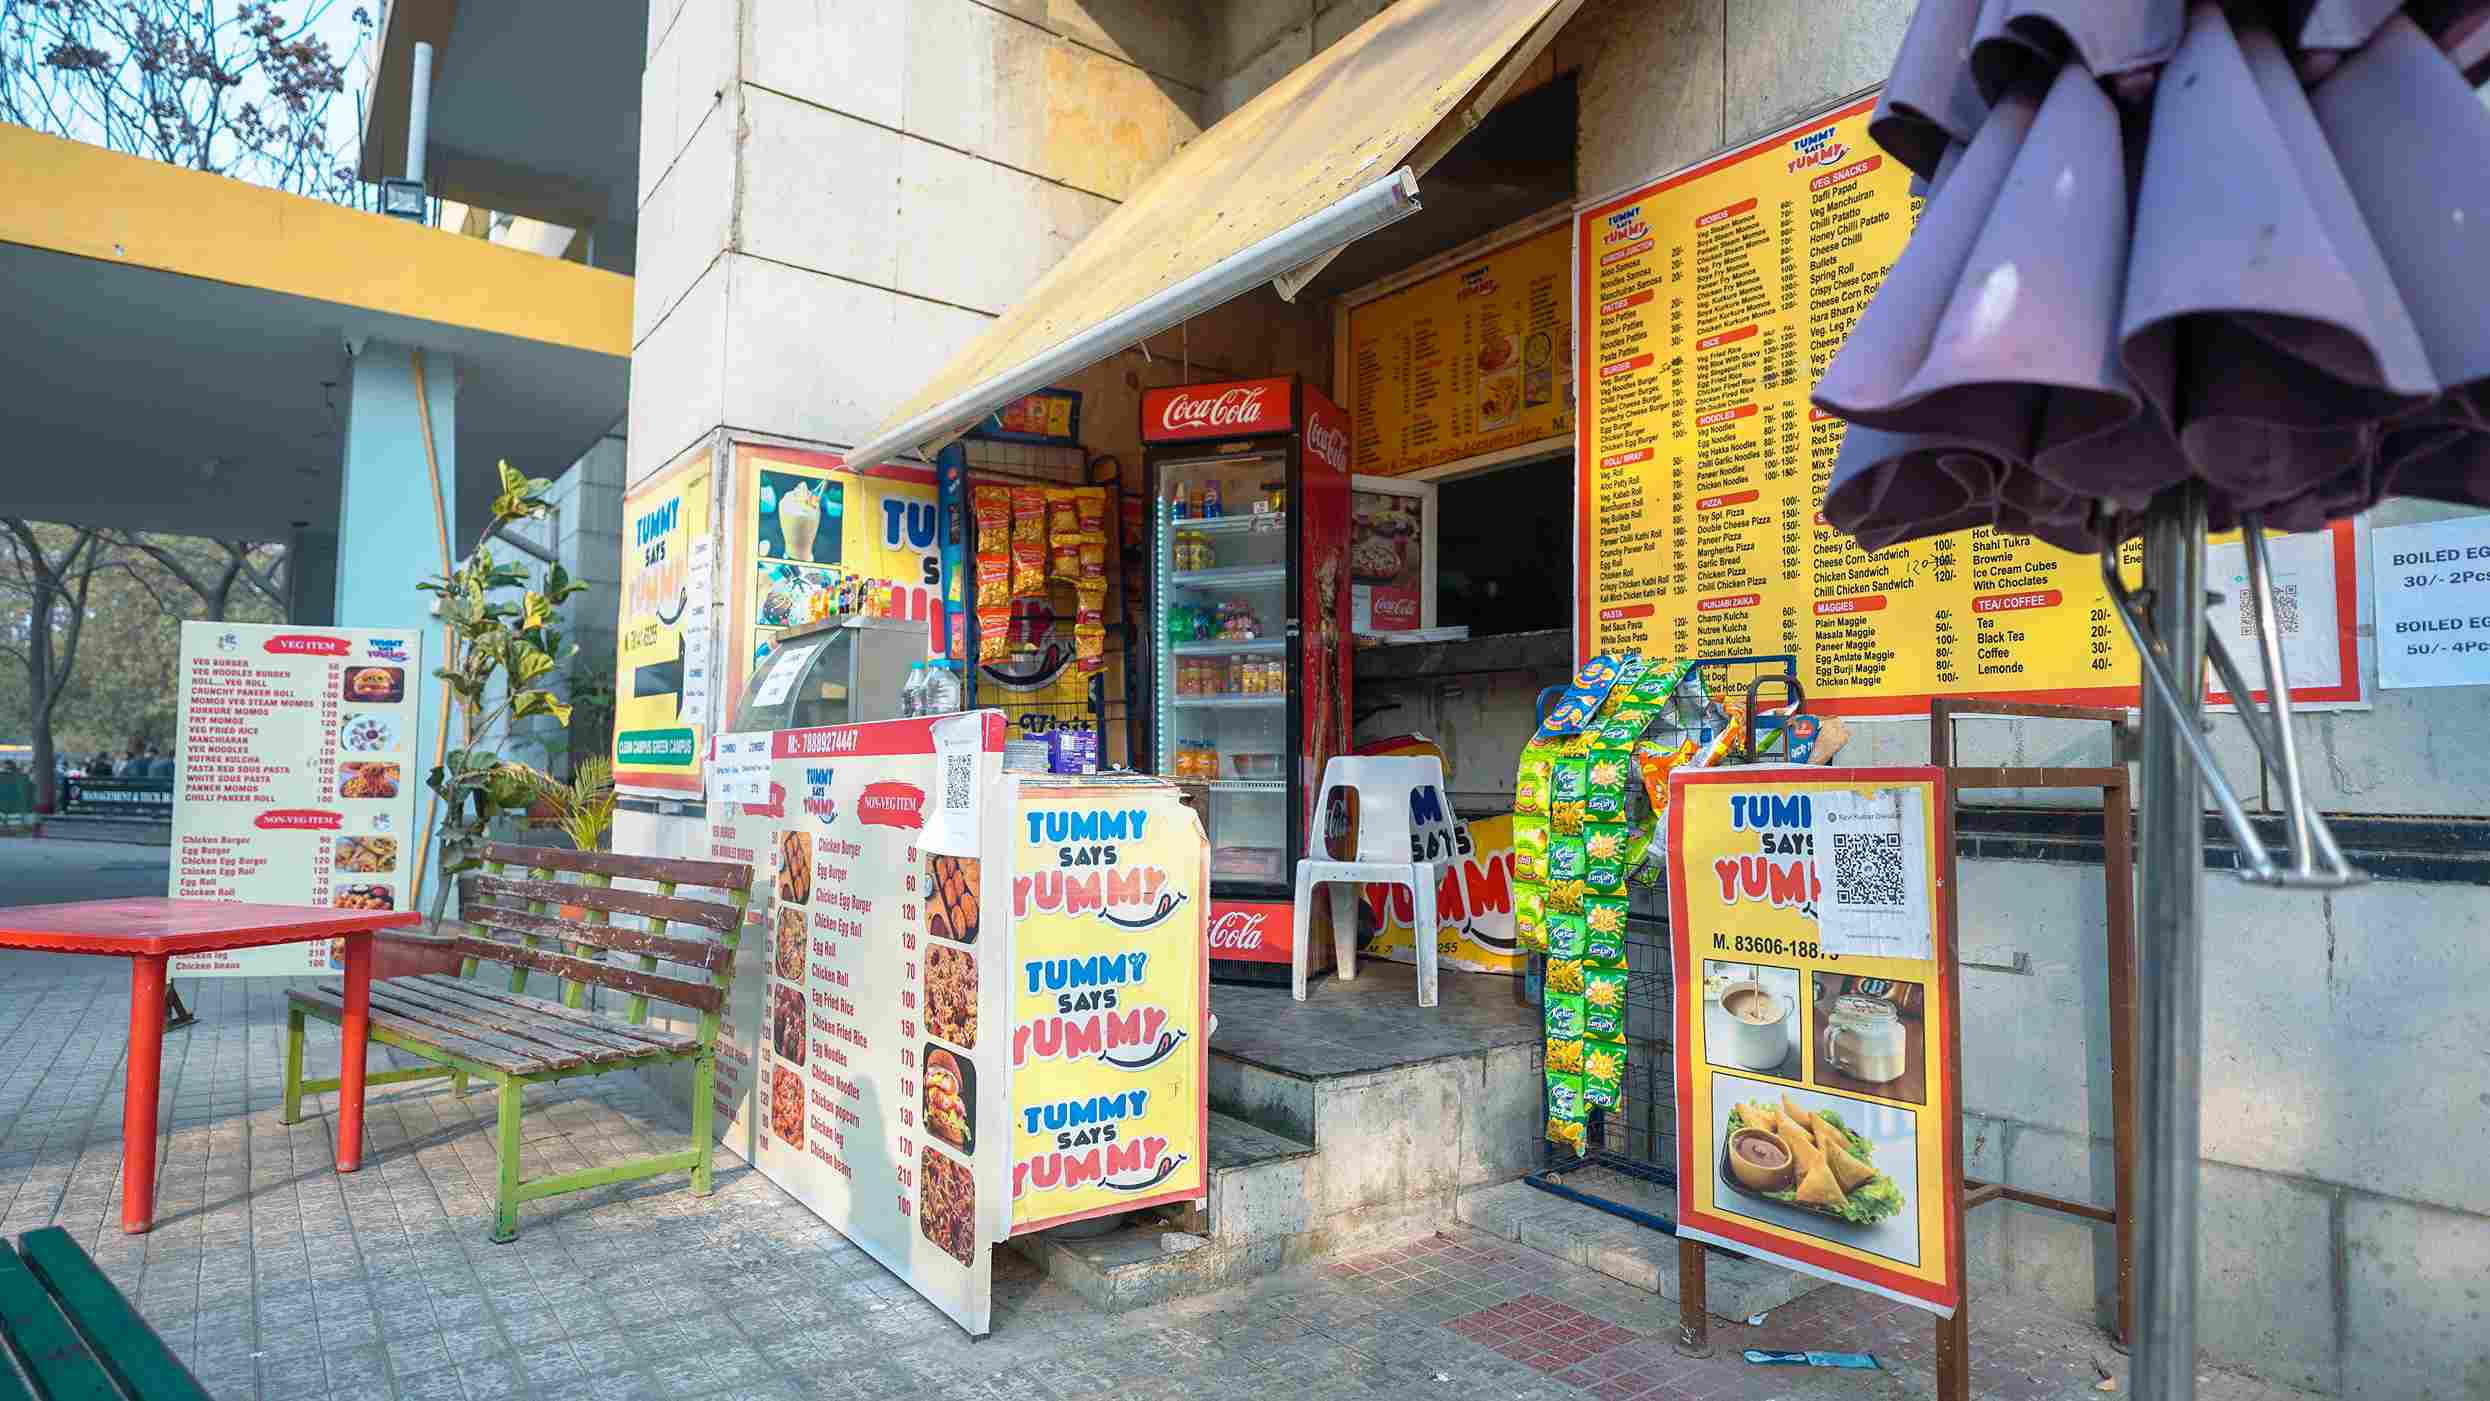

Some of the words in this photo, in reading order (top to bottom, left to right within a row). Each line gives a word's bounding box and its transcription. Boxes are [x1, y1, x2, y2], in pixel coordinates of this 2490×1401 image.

[1793, 127, 1836, 151] TUMMY
[1787, 144, 1845, 175] YUMMY
[1812, 177, 1831, 190] VEG
[1832, 162, 1868, 183] SNACKS
[1810, 207, 1825, 218] Veg
[1810, 230, 1835, 244] Honey
[1810, 242, 1839, 257] Cheese
[1810, 271, 1836, 285] Spring
[1838, 263, 1854, 276] Roll
[1810, 285, 1832, 298] Crispy
[1860, 271, 1879, 282] Corn
[1810, 295, 1839, 311] Cheese
[1841, 288, 1862, 302] Corn
[1810, 311, 1829, 324] Hara
[1831, 303, 1854, 319] Bhara
[636, 497, 680, 547] TUMMY
[1752, 516, 1771, 526] Pizza
[1934, 539, 1956, 550] 100/-
[1972, 540, 2000, 552] Shahi
[2003, 536, 2031, 548] Tukra
[645, 541, 666, 567] SAYS
[1813, 558, 1843, 569] Cheese
[1846, 555, 1865, 565] Corn
[1867, 548, 1909, 562] Sandwich
[1973, 551, 2013, 565] Brownie
[2393, 548, 2461, 567] BOILED
[1727, 568, 1746, 577] Pizza
[1814, 571, 1846, 583] Chicken
[1848, 566, 1889, 580] Sandwich
[1973, 567, 1988, 578] Ice
[1990, 564, 2022, 577] Cream
[2024, 559, 2058, 573] Cubes
[1836, 582, 1870, 595] Chicken
[1872, 577, 1914, 592] Sandwich
[1934, 570, 1957, 582] 120/-
[1973, 579, 1996, 591] With
[1998, 575, 2049, 589] Choclates
[2403, 573, 2445, 588] 30/-
[1817, 601, 1854, 611] MAGGIES
[2003, 595, 2045, 609] COFFEE
[1723, 624, 1747, 632] Kulcha
[1815, 618, 1835, 628] Plain
[1838, 616, 1867, 628] Maggie
[1935, 609, 1952, 620] 40/-
[1976, 617, 1994, 629] Tea
[2090, 608, 2111, 621] 20/-
[2395, 618, 2464, 634] BOILED
[1815, 630, 1843, 640] Masala
[1845, 627, 1876, 640] Maggie
[1935, 622, 1953, 632] 50/-
[1977, 631, 2005, 644] Black
[2006, 630, 2025, 642] Tea
[2091, 625, 2112, 638] 20/-
[280, 640, 304, 649] VEG
[305, 641, 336, 651] ITEM
[1697, 649, 1726, 658] Chicken
[1728, 647, 1752, 656] Kulcha
[1784, 644, 1802, 653] 100/-
[1815, 642, 1844, 651] Paneer
[1845, 640, 1876, 651] Maggie
[1936, 635, 1959, 645] 100/-
[1977, 647, 2010, 659] Coffee
[2091, 641, 2112, 654] 30/-
[2407, 643, 2448, 656] 50/-
[1815, 654, 1832, 664] Egg
[1864, 650, 1895, 662] Maggie
[1978, 661, 2024, 674] Lemonde
[2091, 658, 2112, 671] 40/-
[1815, 665, 1832, 676] Egg
[1833, 664, 1854, 676] Burji
[1855, 662, 1886, 675] Maggie
[1816, 676, 1849, 687] Chicken
[1851, 674, 1881, 688] Maggie
[1937, 672, 1959, 682] 100/-
[806, 768, 834, 785] TUMMY
[804, 798, 835, 816] YUMMY
[896, 796, 917, 811] ITEM
[1731, 794, 1813, 829] TUM
[308, 816, 334, 825] ITEM
[1026, 809, 1148, 843] TUMMY
[182, 835, 219, 844] Chicken
[181, 856, 217, 865] Chicken
[219, 857, 237, 867] Egg
[907, 845, 917, 862] 90
[1059, 845, 1118, 867] SAYS
[817, 862, 828, 880] Egg
[906, 875, 916, 892] 60
[1714, 856, 1821, 905] YUM
[179, 888, 216, 897] Chicken
[217, 888, 236, 897] Roll
[1012, 866, 1166, 917] YUMMY
[851, 895, 872, 915] Burger
[902, 903, 916, 921] 120
[815, 912, 837, 931] Chicken
[838, 918, 849, 938] Egg
[850, 921, 862, 938] Roll
[812, 937, 824, 957] Egg
[825, 941, 836, 957] Roll
[1712, 932, 1730, 951] M.
[1734, 934, 1840, 961] 83606-188
[812, 962, 836, 984] Chicken
[837, 970, 849, 988] Roll
[906, 962, 916, 980] 70
[1025, 951, 1148, 993] TUMMY
[812, 987, 823, 1008] Egg
[823, 992, 839, 1011] Fried
[840, 997, 855, 1017] Rice
[901, 989, 916, 1009] 100
[1058, 988, 1117, 1014] SAYS
[836, 1022, 852, 1043] Fried
[853, 1029, 868, 1049] Rice
[901, 1019, 915, 1039] 150
[1012, 1006, 1167, 1066] YUMMY
[900, 1048, 914, 1068] 170
[811, 1063, 835, 1087] Chicken
[836, 1076, 860, 1101] Noodles
[900, 1077, 914, 1098] 110
[900, 1107, 913, 1128] 130
[1024, 1089, 1148, 1134] TUMMY
[899, 1135, 913, 1158] 170
[1057, 1125, 1117, 1150] SAYS
[897, 1165, 912, 1187] 210
[1012, 1135, 1167, 1198] YUMMY
